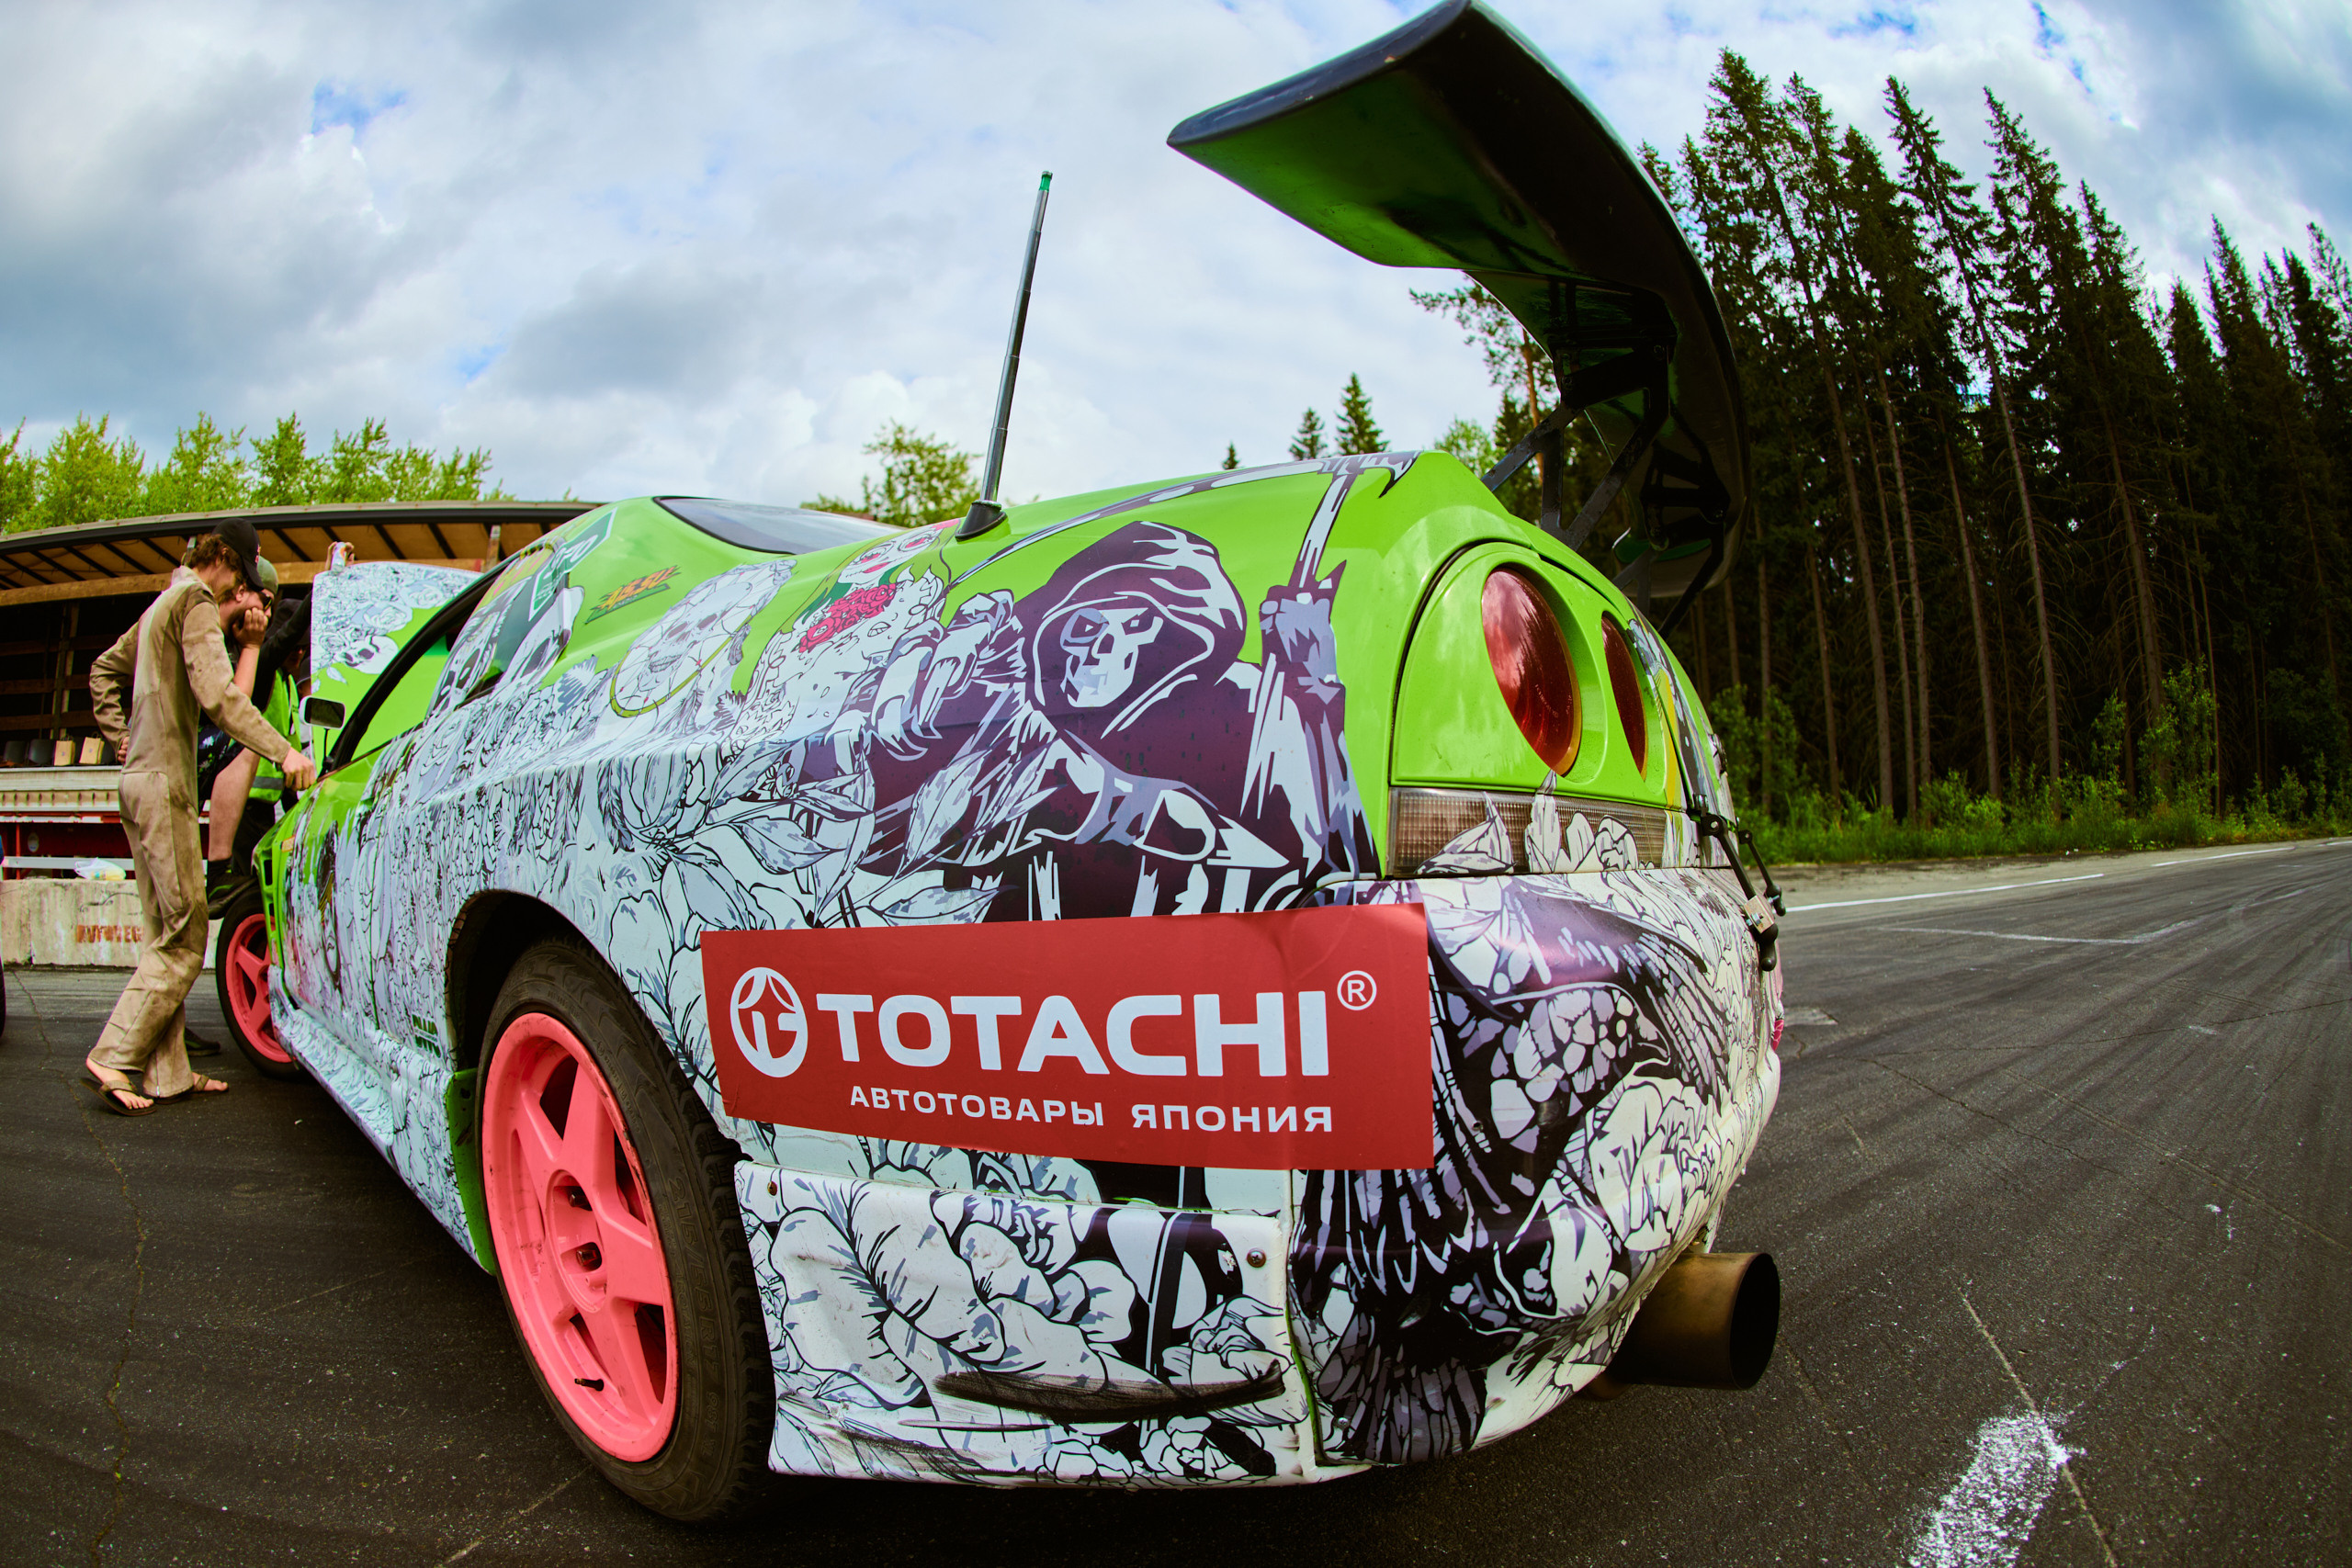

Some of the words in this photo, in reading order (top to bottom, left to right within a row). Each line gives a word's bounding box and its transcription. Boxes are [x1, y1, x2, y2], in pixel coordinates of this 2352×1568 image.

[816, 990, 1329, 1078] TOTACHI
[850, 1085, 1104, 1126] АВТОТОВАРЫ
[1131, 1103, 1332, 1134] ЯПОНИЯ
